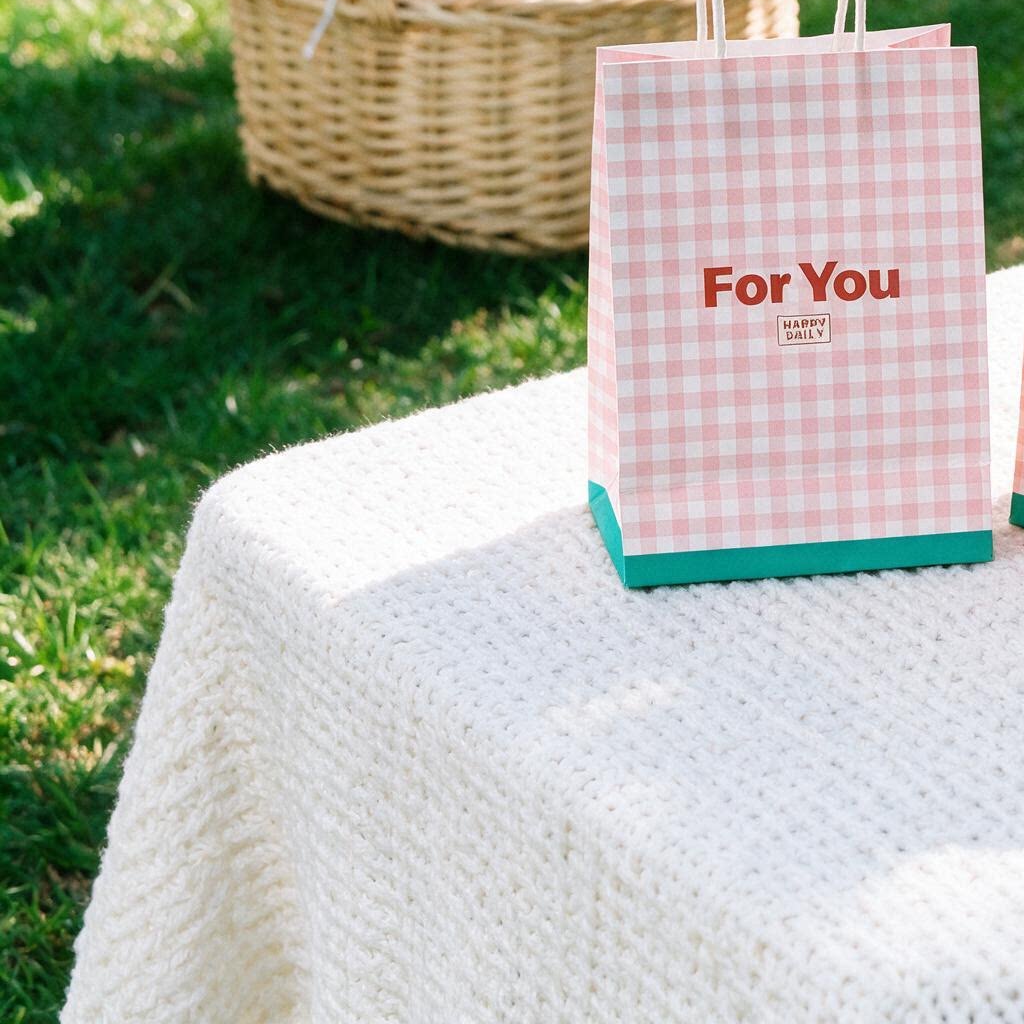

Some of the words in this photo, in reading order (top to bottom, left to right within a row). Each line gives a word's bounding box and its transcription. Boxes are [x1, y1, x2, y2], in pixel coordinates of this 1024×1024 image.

[703, 266, 791, 308] For
[798, 261, 900, 302] You
[783, 317, 826, 330] HAPPY
[786, 328, 824, 340] DAILY
